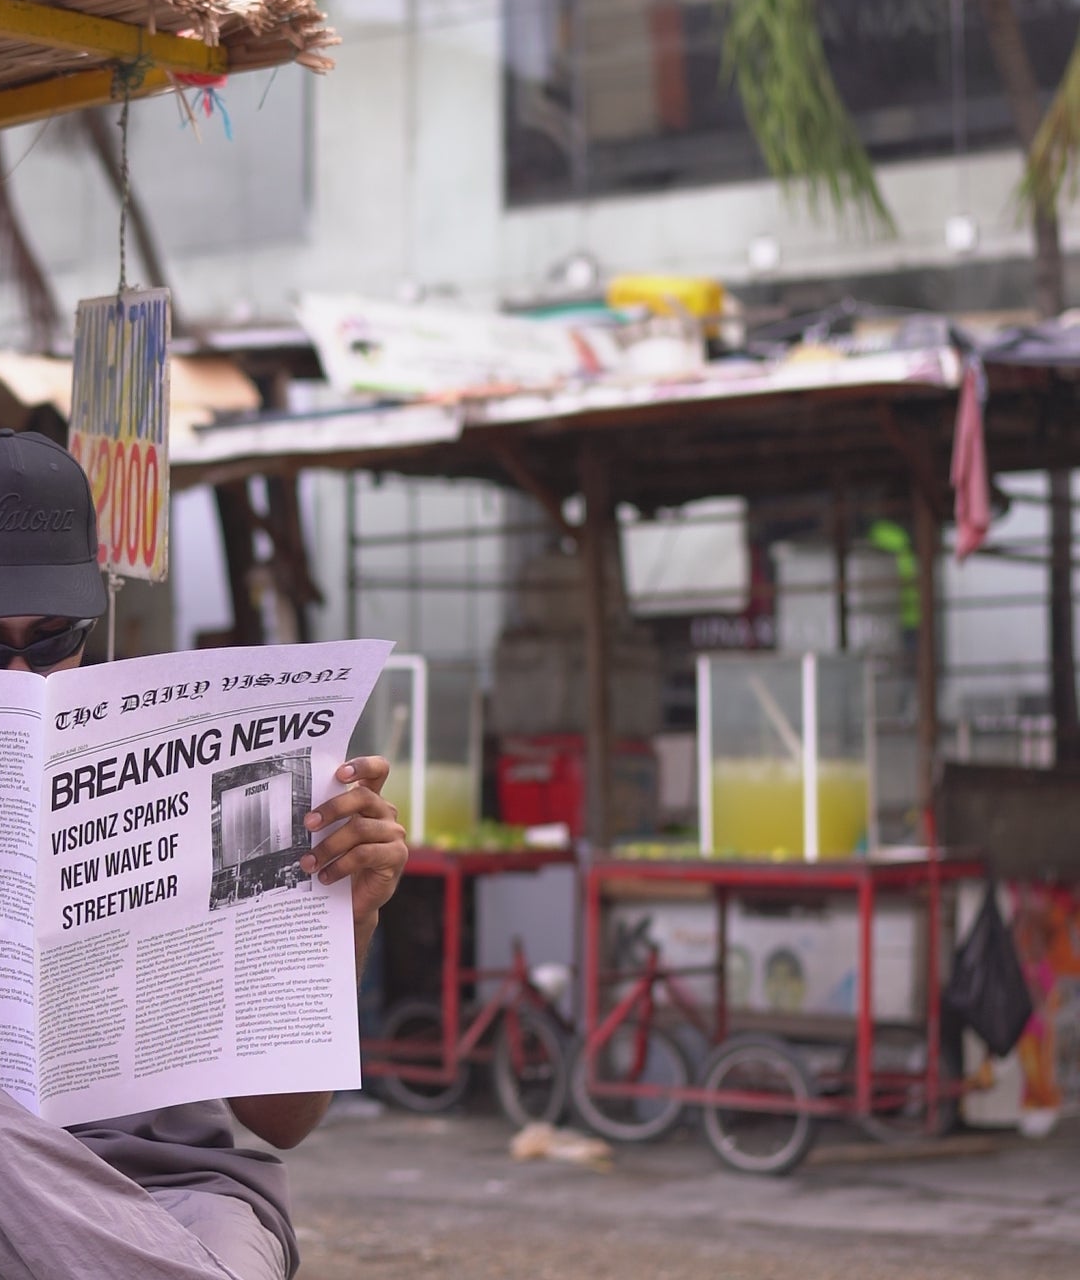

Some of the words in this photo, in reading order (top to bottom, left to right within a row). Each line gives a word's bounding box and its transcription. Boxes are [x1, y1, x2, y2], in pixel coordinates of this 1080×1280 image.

[55, 701, 109, 730] THE
[120, 680, 210, 714] DAILY
[222, 668, 352, 692] VISIONZ
[52, 728, 222, 812] BREAKING
[230, 710, 334, 756] NEWS
[52, 813, 118, 856] VISIONZ
[123, 792, 189, 832] SPARKS
[60, 858, 100, 891] NEW
[105, 841, 152, 878] WAVE
[158, 833, 178, 862] OF
[62, 874, 178, 930] STREETWEAR
